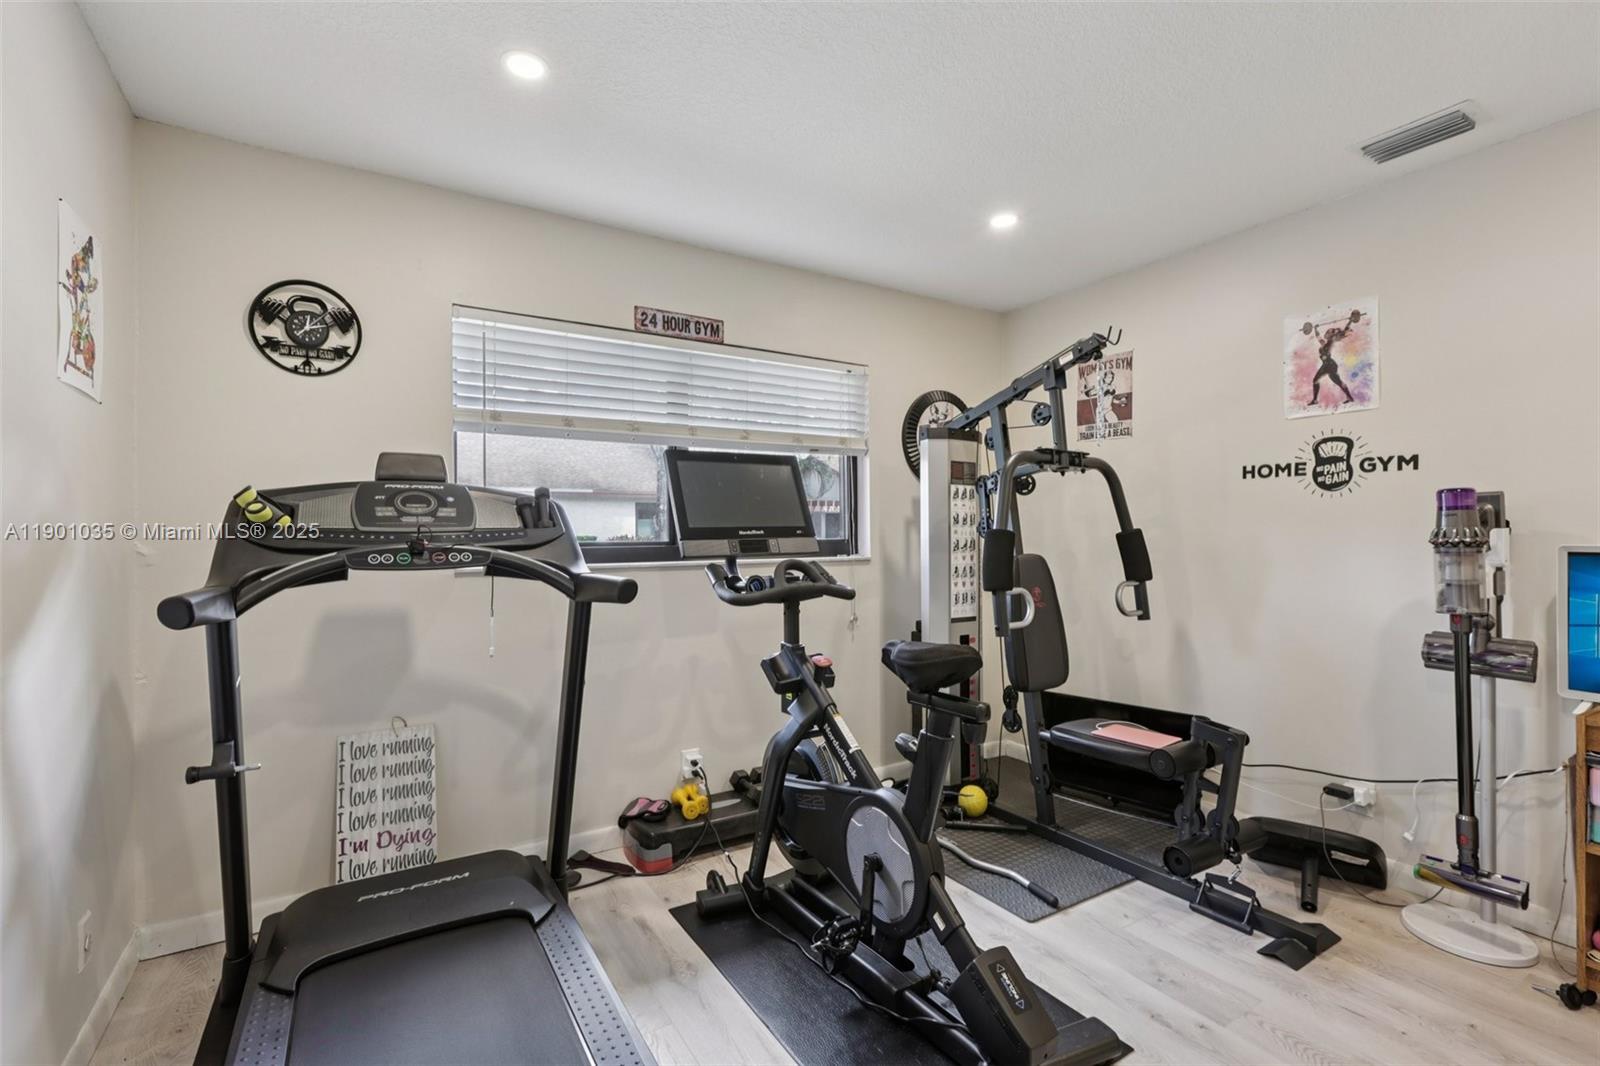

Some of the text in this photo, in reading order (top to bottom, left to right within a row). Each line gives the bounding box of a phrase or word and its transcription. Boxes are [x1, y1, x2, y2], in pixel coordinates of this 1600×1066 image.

[640, 311, 720, 338] 24 HOUR GYM
[1115, 356, 1133, 371] GYM
[1242, 462, 1307, 479] HOME
[1324, 461, 1347, 475] PAIN
[1325, 471, 1349, 484] GAIN
[1359, 454, 1419, 473] GYM
[339, 735, 435, 763] I love running
[823, 723, 857, 780] NordicTrack
[339, 756, 435, 786] I love running
[338, 777, 435, 809] I love running
[337, 801, 436, 834] I love running
[338, 827, 437, 857] I'm Dying
[337, 848, 437, 884] I love running
[357, 872, 470, 902] PRO-FORM
